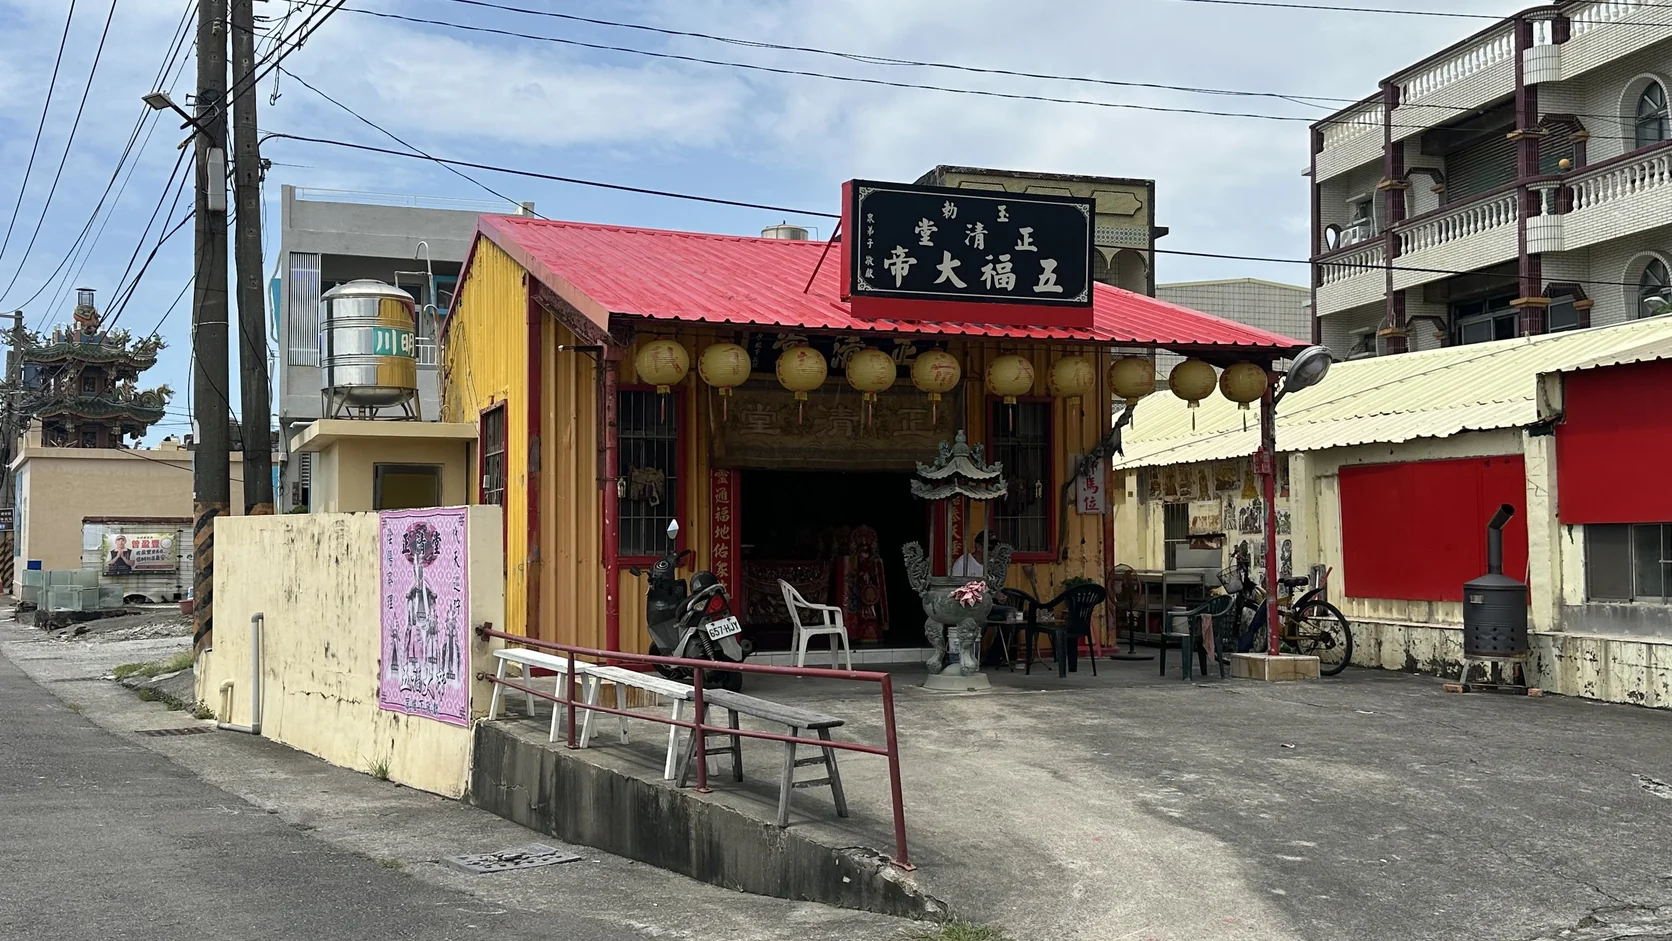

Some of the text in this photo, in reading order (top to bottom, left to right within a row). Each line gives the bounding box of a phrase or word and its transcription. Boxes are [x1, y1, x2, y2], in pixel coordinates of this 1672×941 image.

[914, 217, 1038, 252] 正清堂
[883, 244, 1064, 293] 五福大帝
[738, 402, 934, 438] 正清堂
[709, 621, 739, 638] 657-HJY
